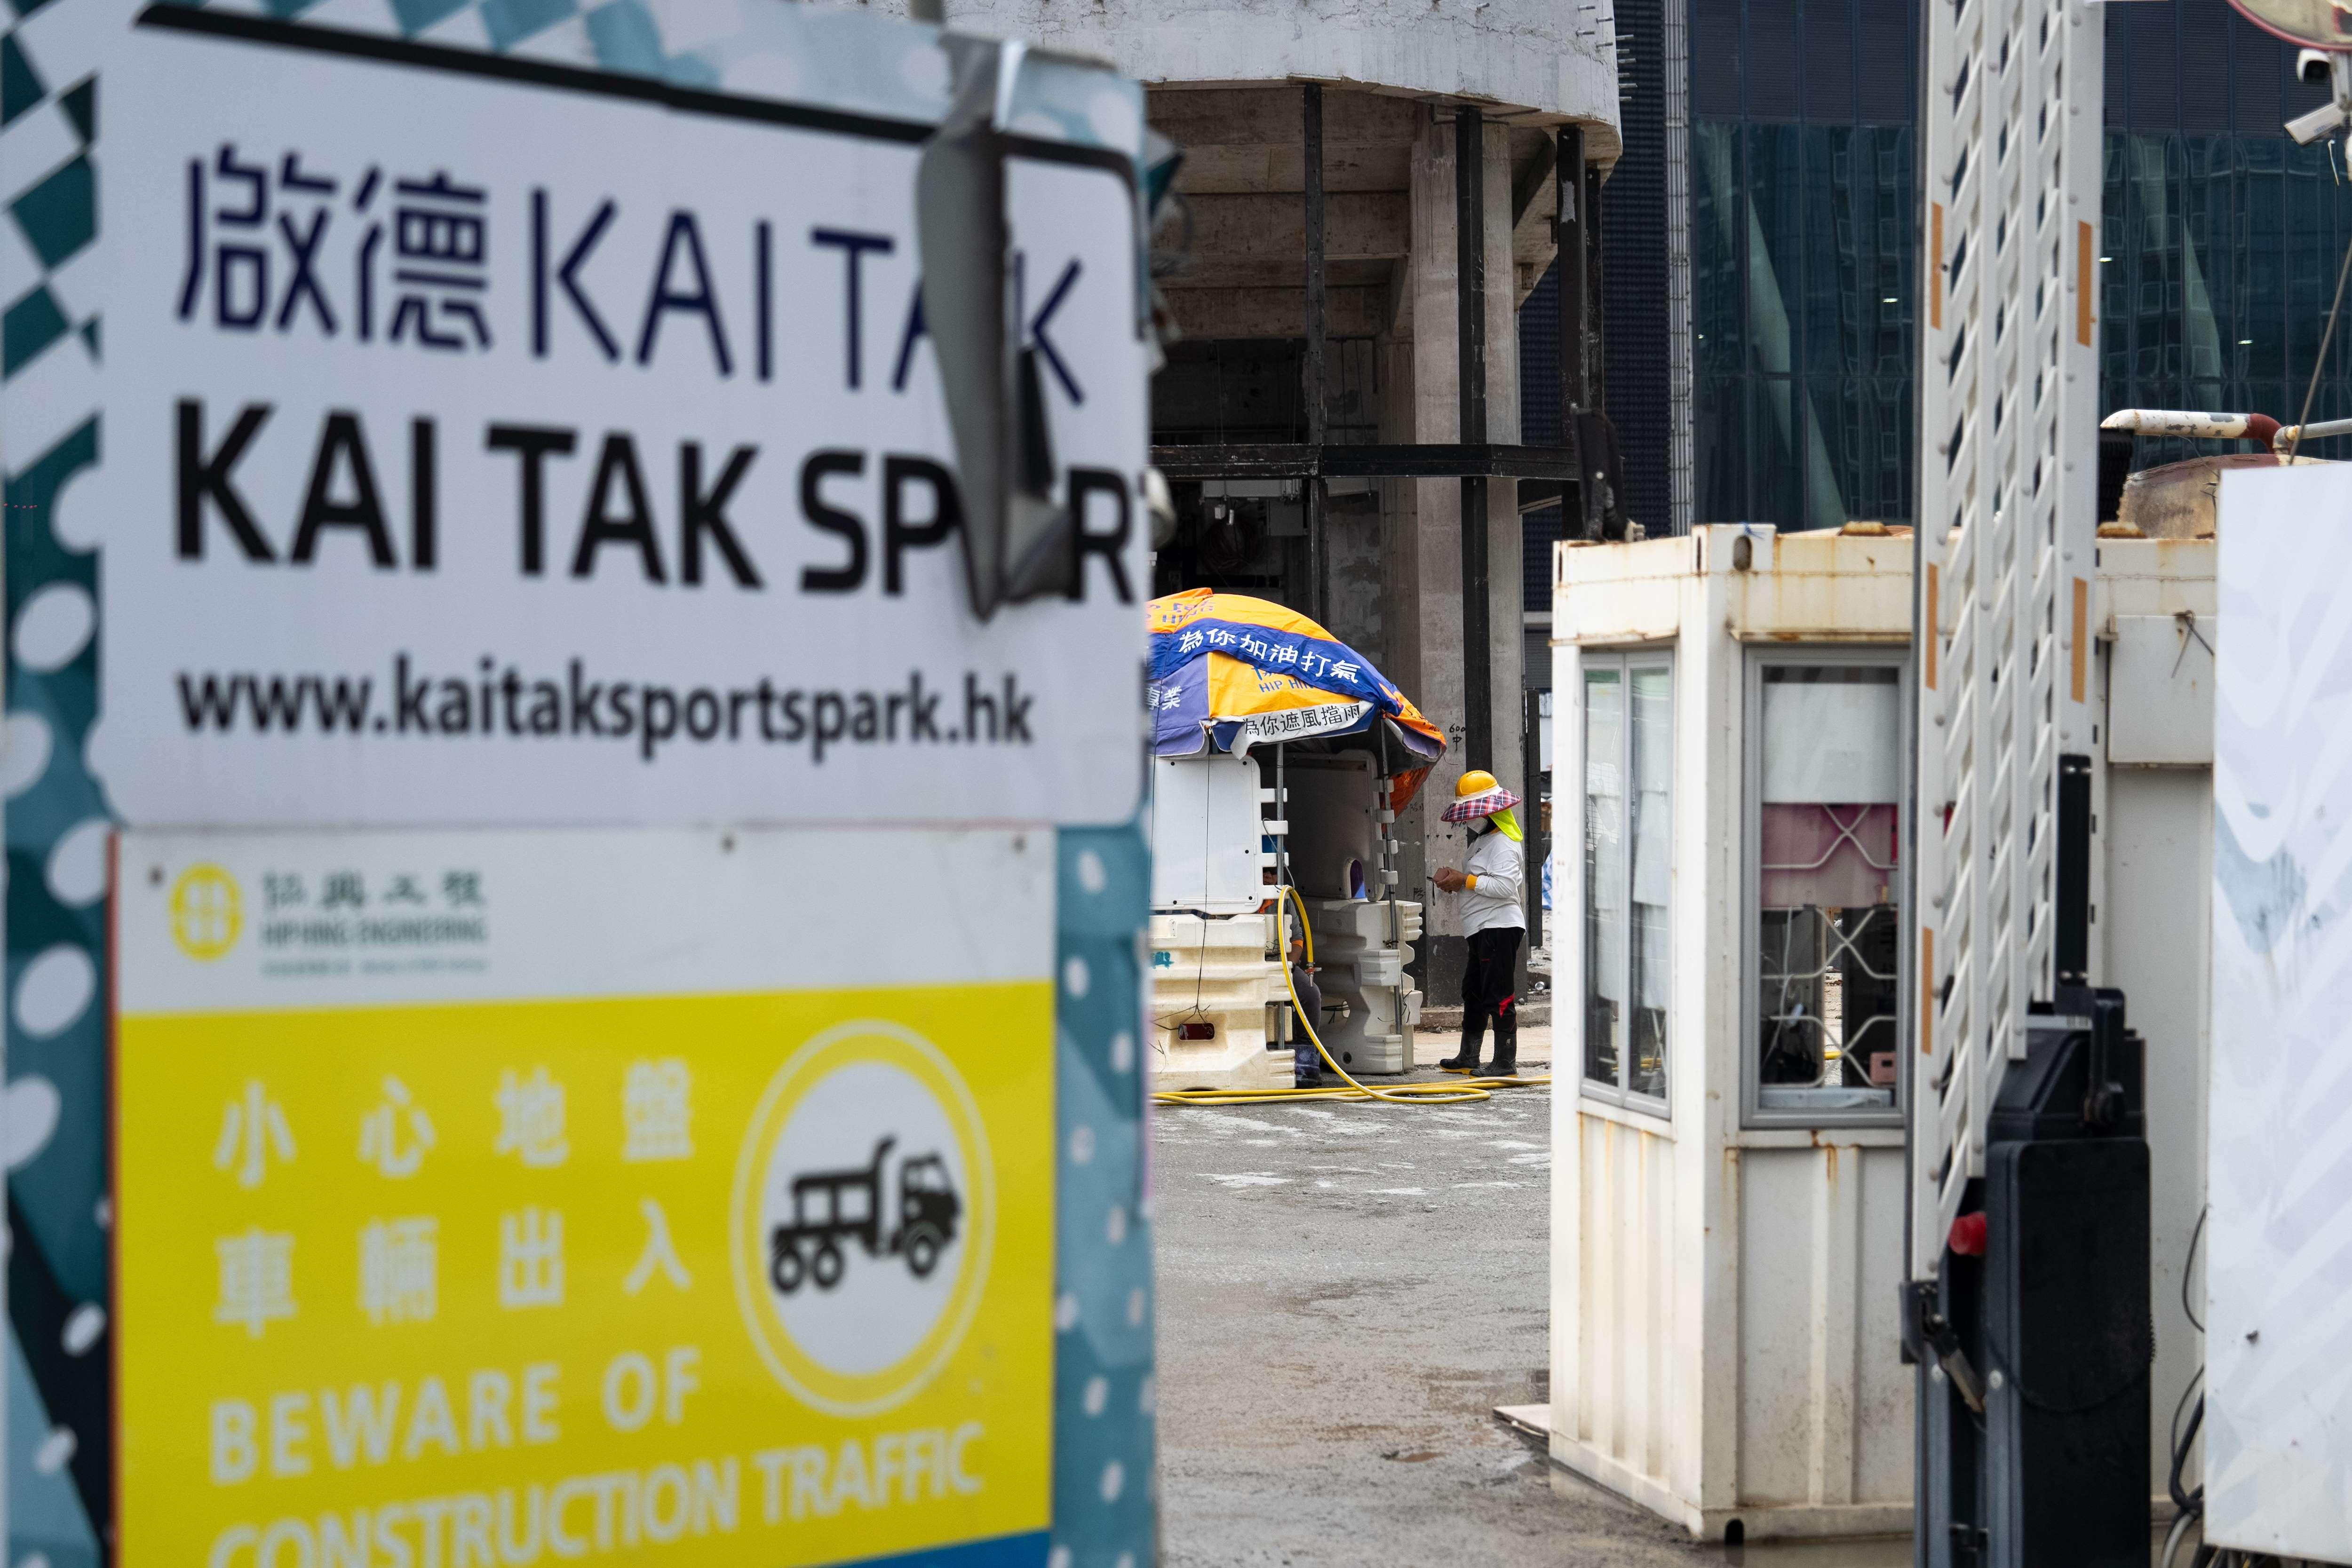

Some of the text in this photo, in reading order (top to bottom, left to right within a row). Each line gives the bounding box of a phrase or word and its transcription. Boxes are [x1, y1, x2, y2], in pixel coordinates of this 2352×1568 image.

[529, 186, 773, 384] KAI
[173, 397, 440, 573] KAI
[485, 423, 767, 594] TAK
[176, 654, 1034, 763] www.kaitaksportspark.hk
[1178, 628, 1361, 684] 為你加油打氣
[1258, 680, 1283, 693] HIP
[1243, 705, 1360, 736] 為你遮風擋雨
[213, 1056, 695, 1188] 小心地盤
[213, 1197, 693, 1338] 車輛出入
[210, 1346, 702, 1485] BEWARE OF
[754, 1421, 985, 1526] TRAFFIC
